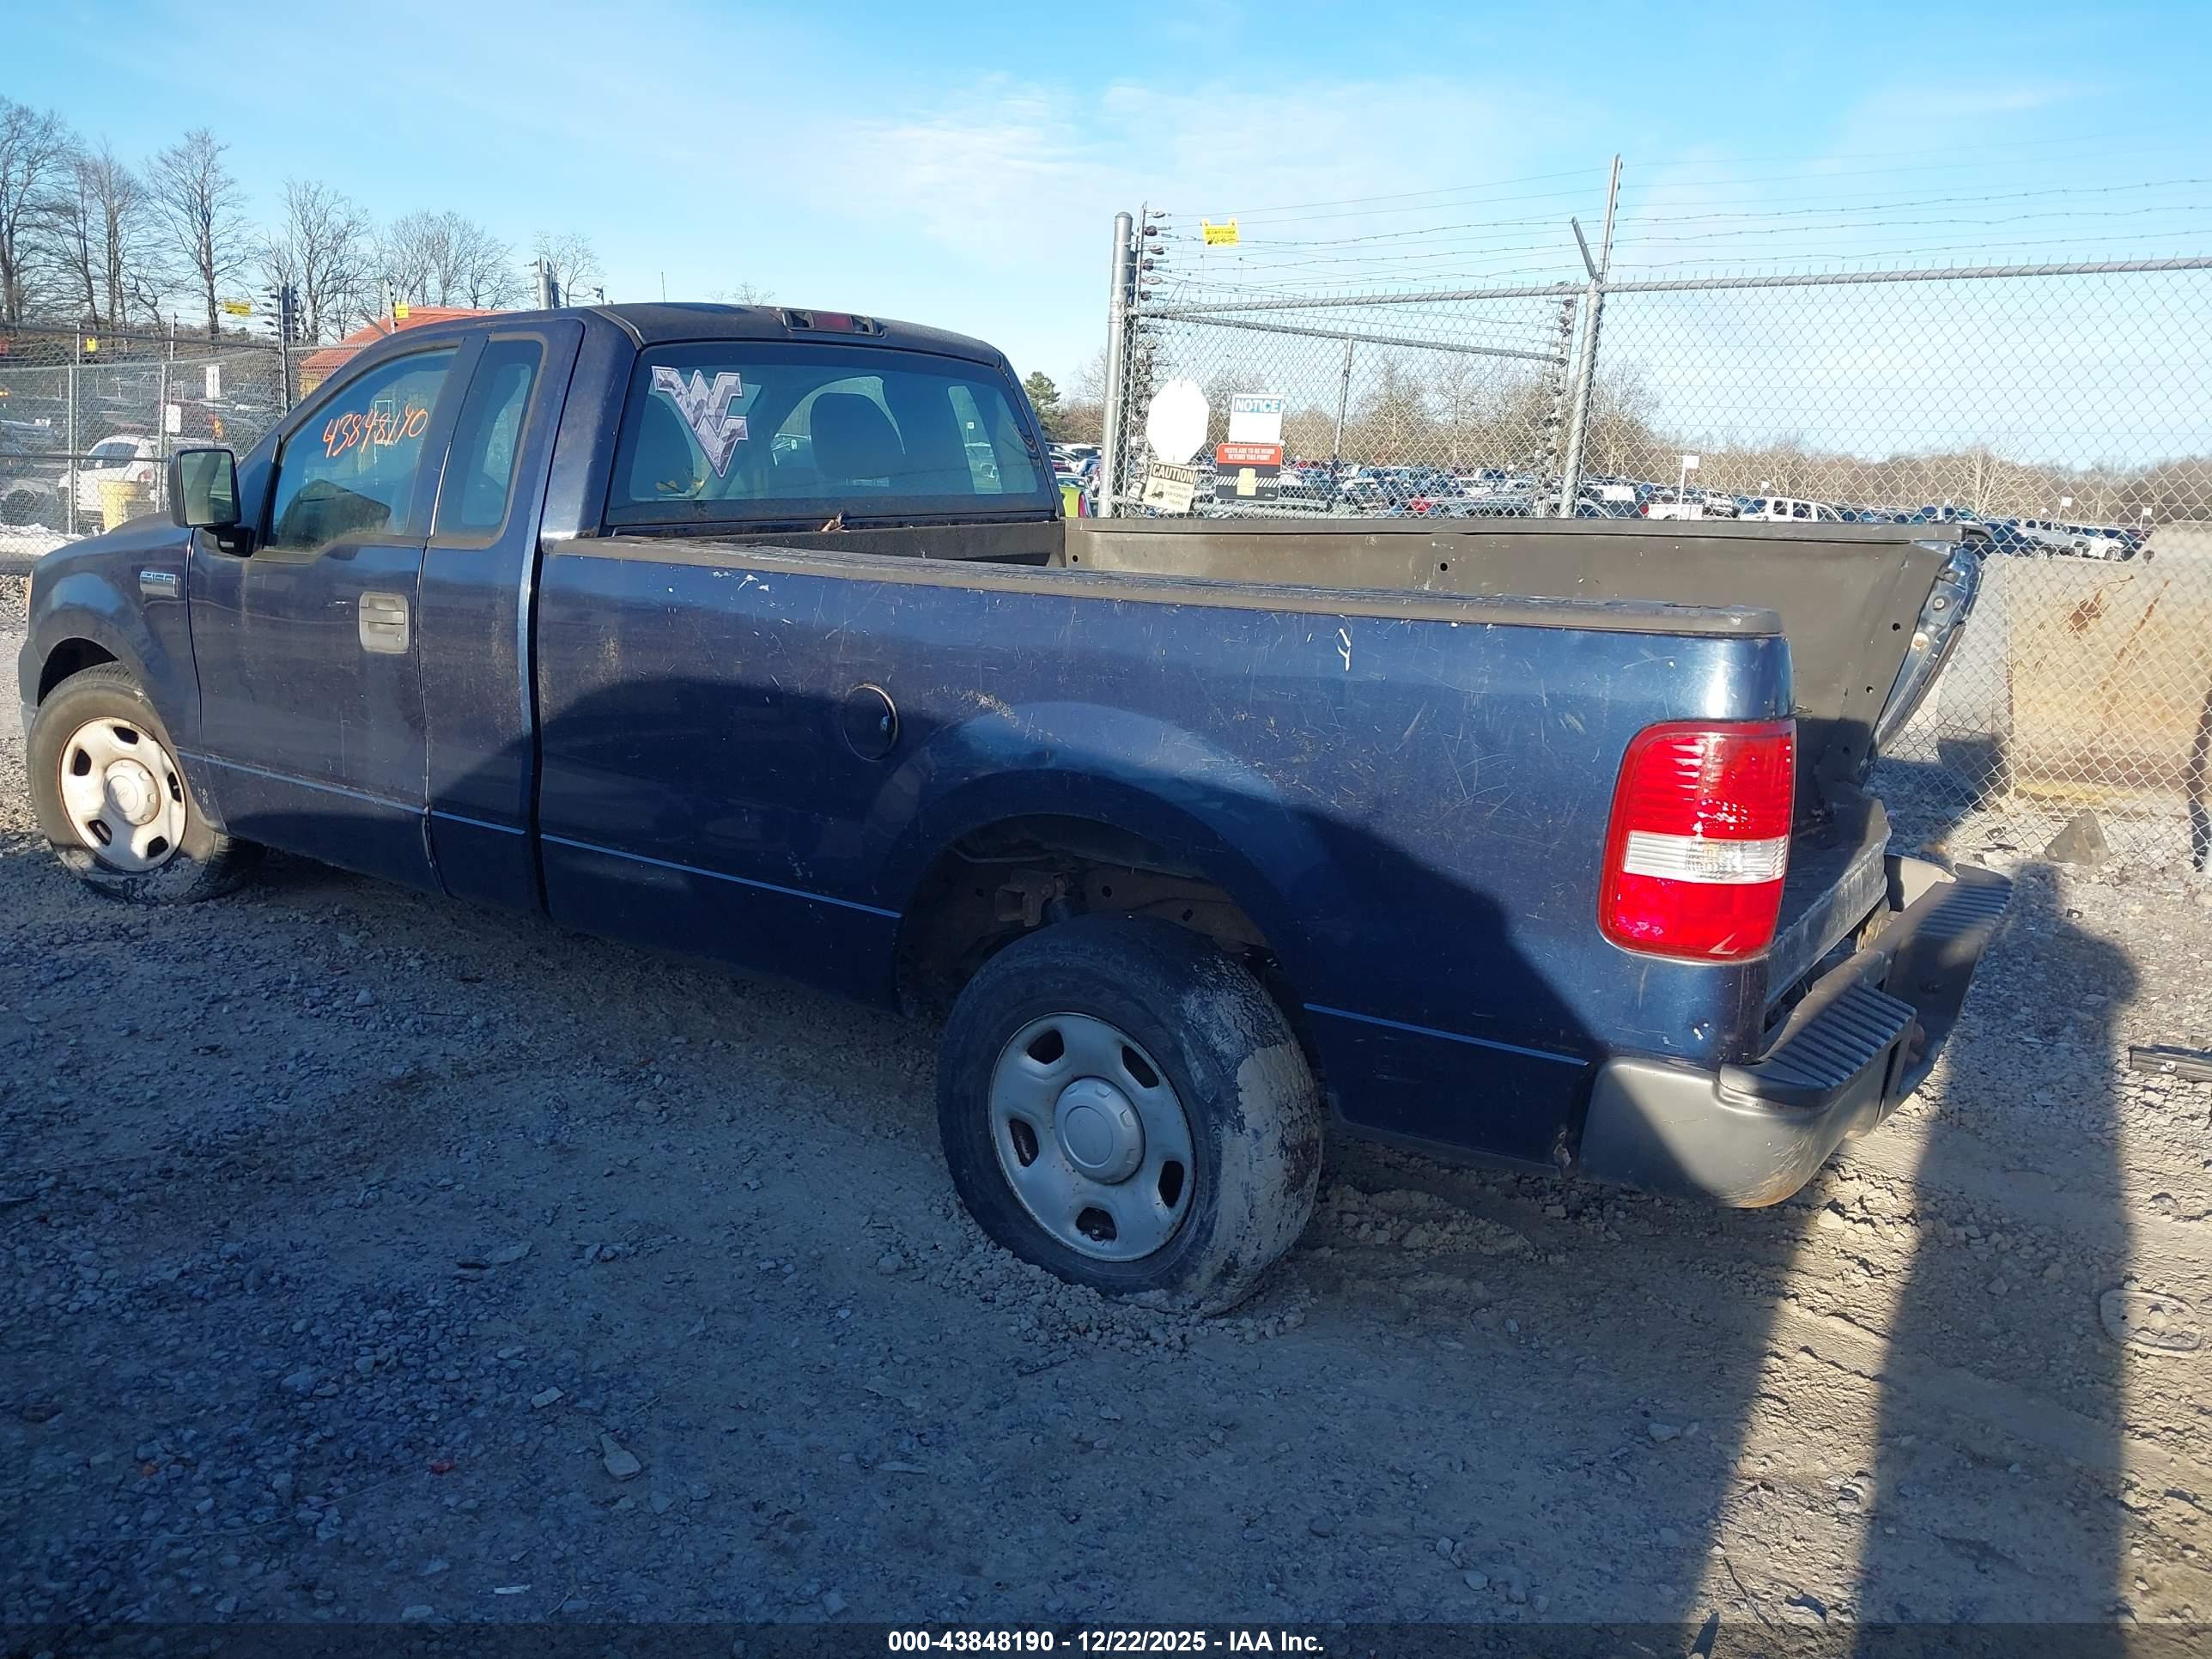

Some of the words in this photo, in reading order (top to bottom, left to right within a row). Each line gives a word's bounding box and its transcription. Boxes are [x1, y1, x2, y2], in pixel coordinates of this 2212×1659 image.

[1235, 398, 1279, 413] NOTICE
[322, 403, 429, 459] 43848190
[1152, 464, 1195, 484] CAUTION
